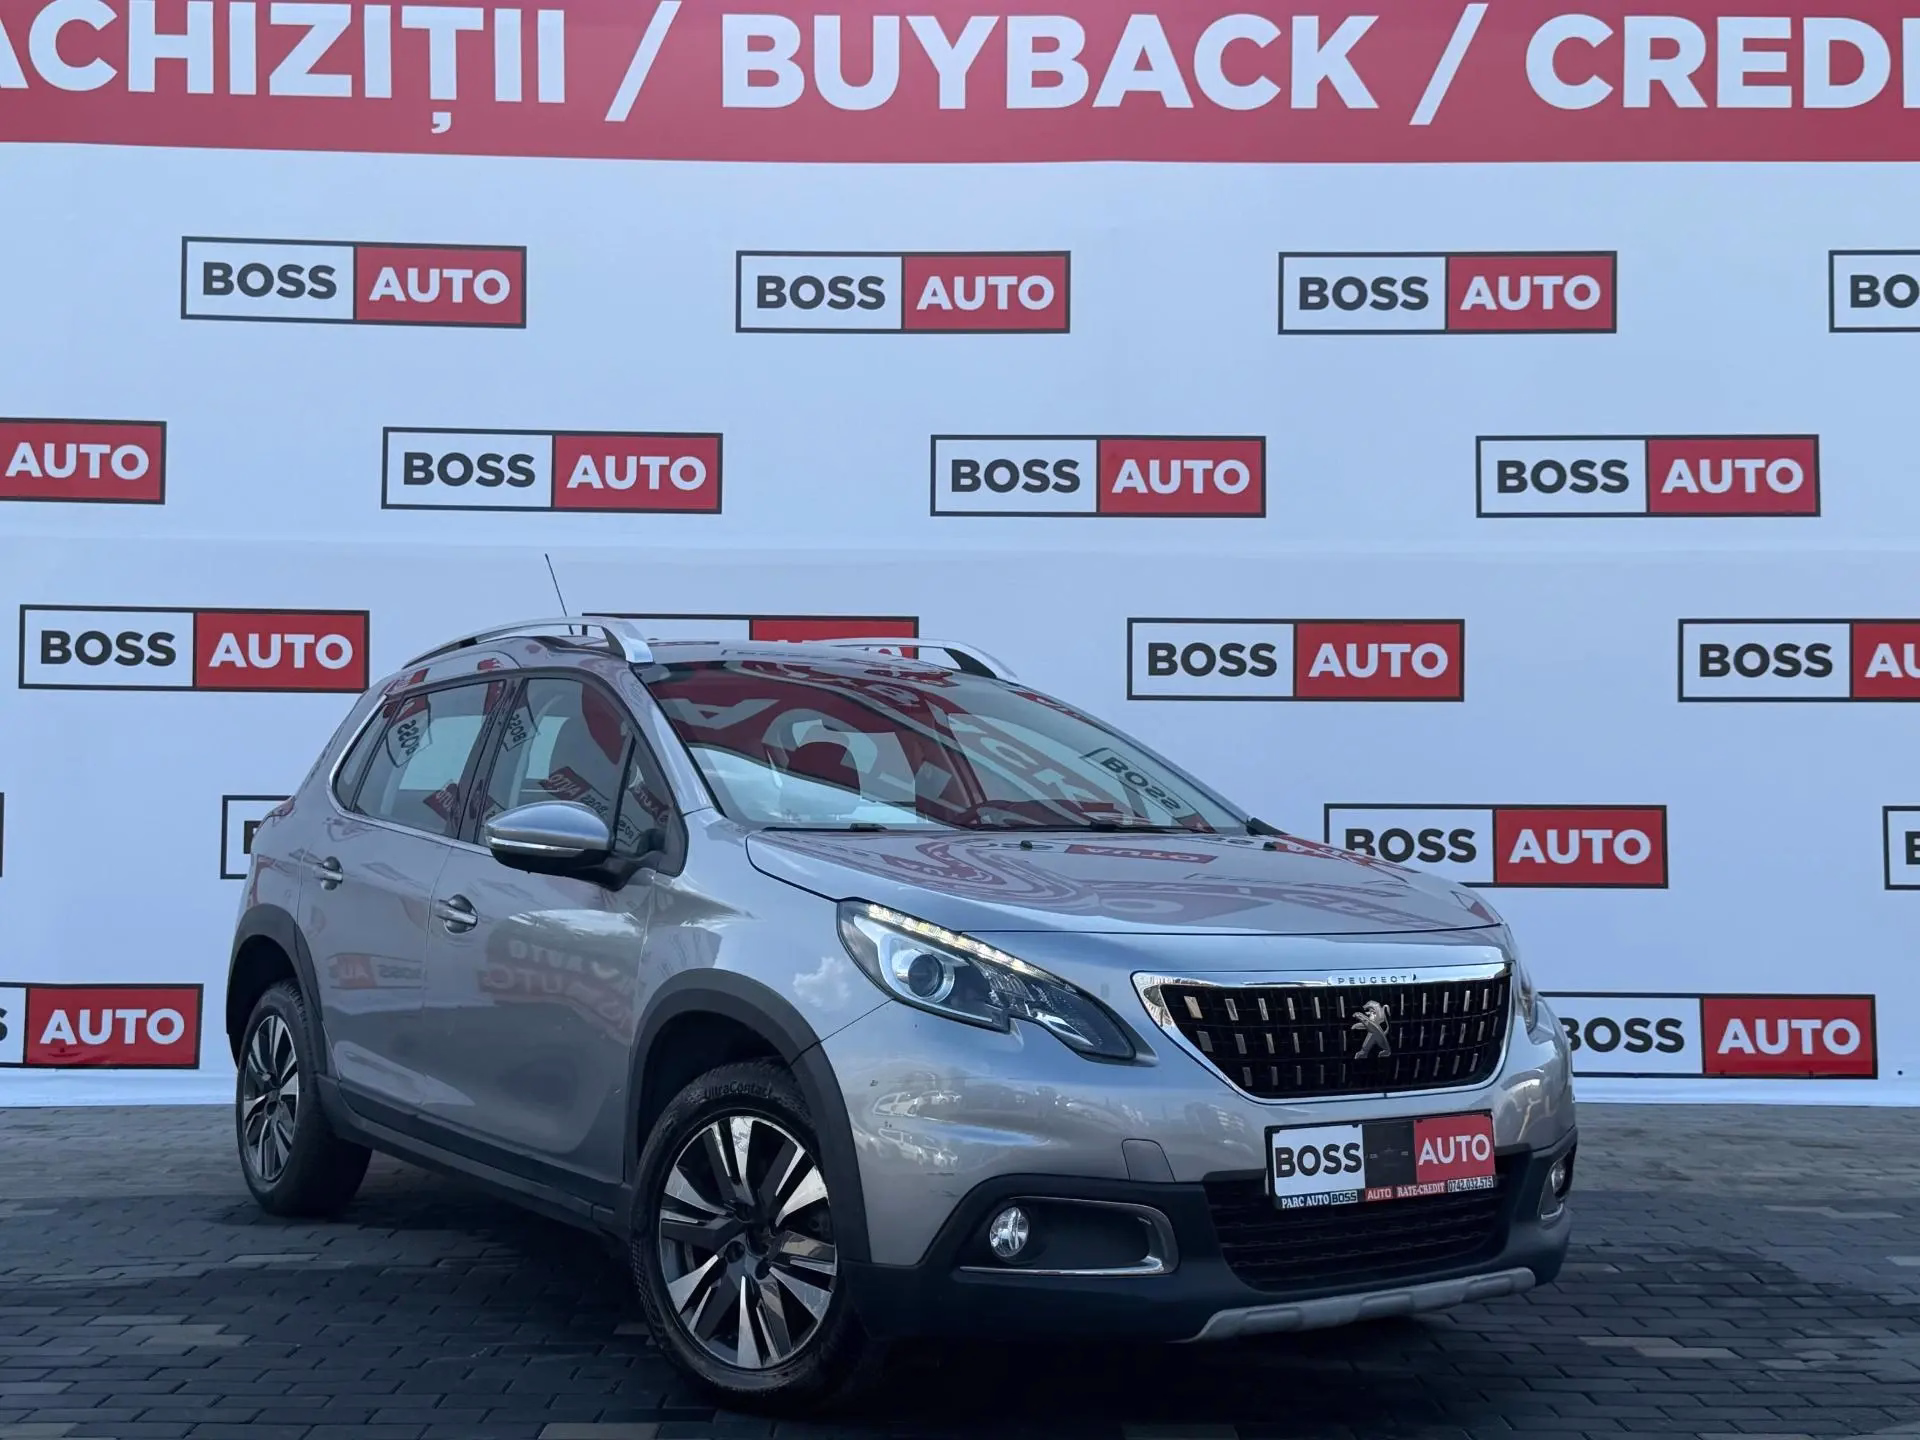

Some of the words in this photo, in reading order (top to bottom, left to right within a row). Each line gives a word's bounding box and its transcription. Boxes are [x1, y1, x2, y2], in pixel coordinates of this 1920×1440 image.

[605, 0, 681, 121] /
[722, 14, 1378, 110] BUYBACK
[1410, 4, 1488, 125] /
[1526, 14, 1920, 109] CREDI
[203, 262, 336, 299] BOSS
[369, 267, 510, 304] AUTO
[757, 276, 885, 310] BOSS
[917, 276, 1054, 310] AUTO
[1300, 277, 1428, 310] BOSS
[1461, 275, 1600, 310] AUTO
[6, 443, 149, 479] AUTO
[404, 452, 535, 487] BOSS
[567, 455, 706, 490] AUTO
[952, 459, 1080, 493] BOSS
[1112, 459, 1249, 494] AUTO
[1498, 460, 1629, 493] BOSS
[1662, 459, 1803, 493] AUTO
[41, 631, 176, 666] BOSS
[209, 633, 352, 669] AUTO
[1149, 643, 1277, 677] BOSS
[1309, 643, 1448, 678] AUTO
[1700, 643, 1832, 677] BOSS
[1345, 828, 1476, 863] BOSS
[1509, 829, 1651, 864] AUTO
[1338, 975, 1407, 984] PEUGEOT
[40, 1009, 184, 1044] AUTO
[1718, 1019, 1860, 1054] AUTO
[1275, 1142, 1363, 1178] BOSS
[1418, 1133, 1490, 1166] AUTO
[1282, 1197, 1305, 1209] PARC
[1306, 1194, 1330, 1207] AUTO
[1331, 1191, 1358, 1204] BOSS
[1367, 1188, 1392, 1200] AUTO
